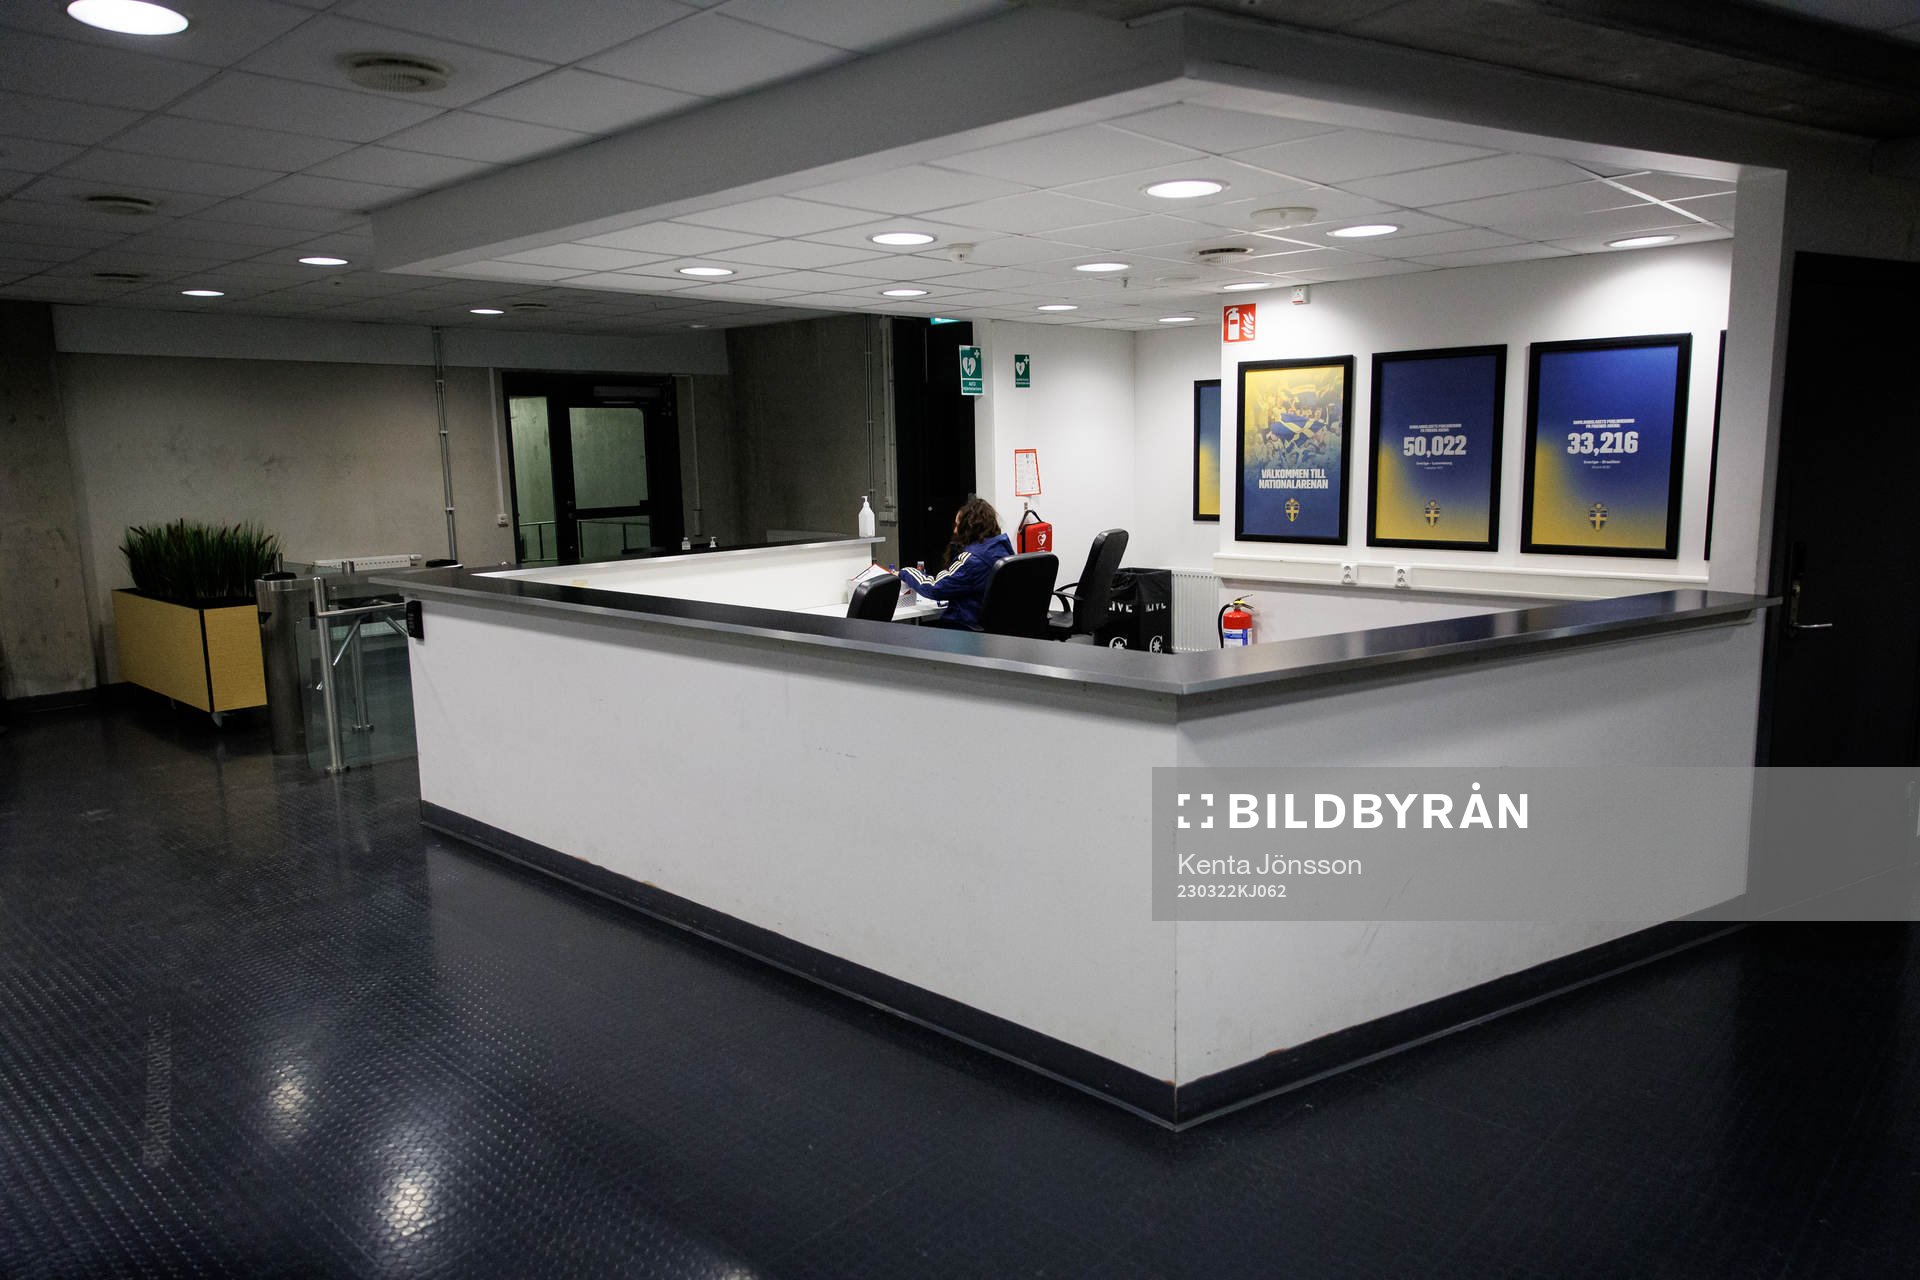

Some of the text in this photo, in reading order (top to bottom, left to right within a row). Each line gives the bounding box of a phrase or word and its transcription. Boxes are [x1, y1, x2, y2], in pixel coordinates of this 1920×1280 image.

[1403, 435, 1467, 458] 50,022
[1567, 431, 1639, 456] 33,216
[1310, 468, 1326, 479] TILL
[1259, 479, 1329, 489] NATIONALARENAN
